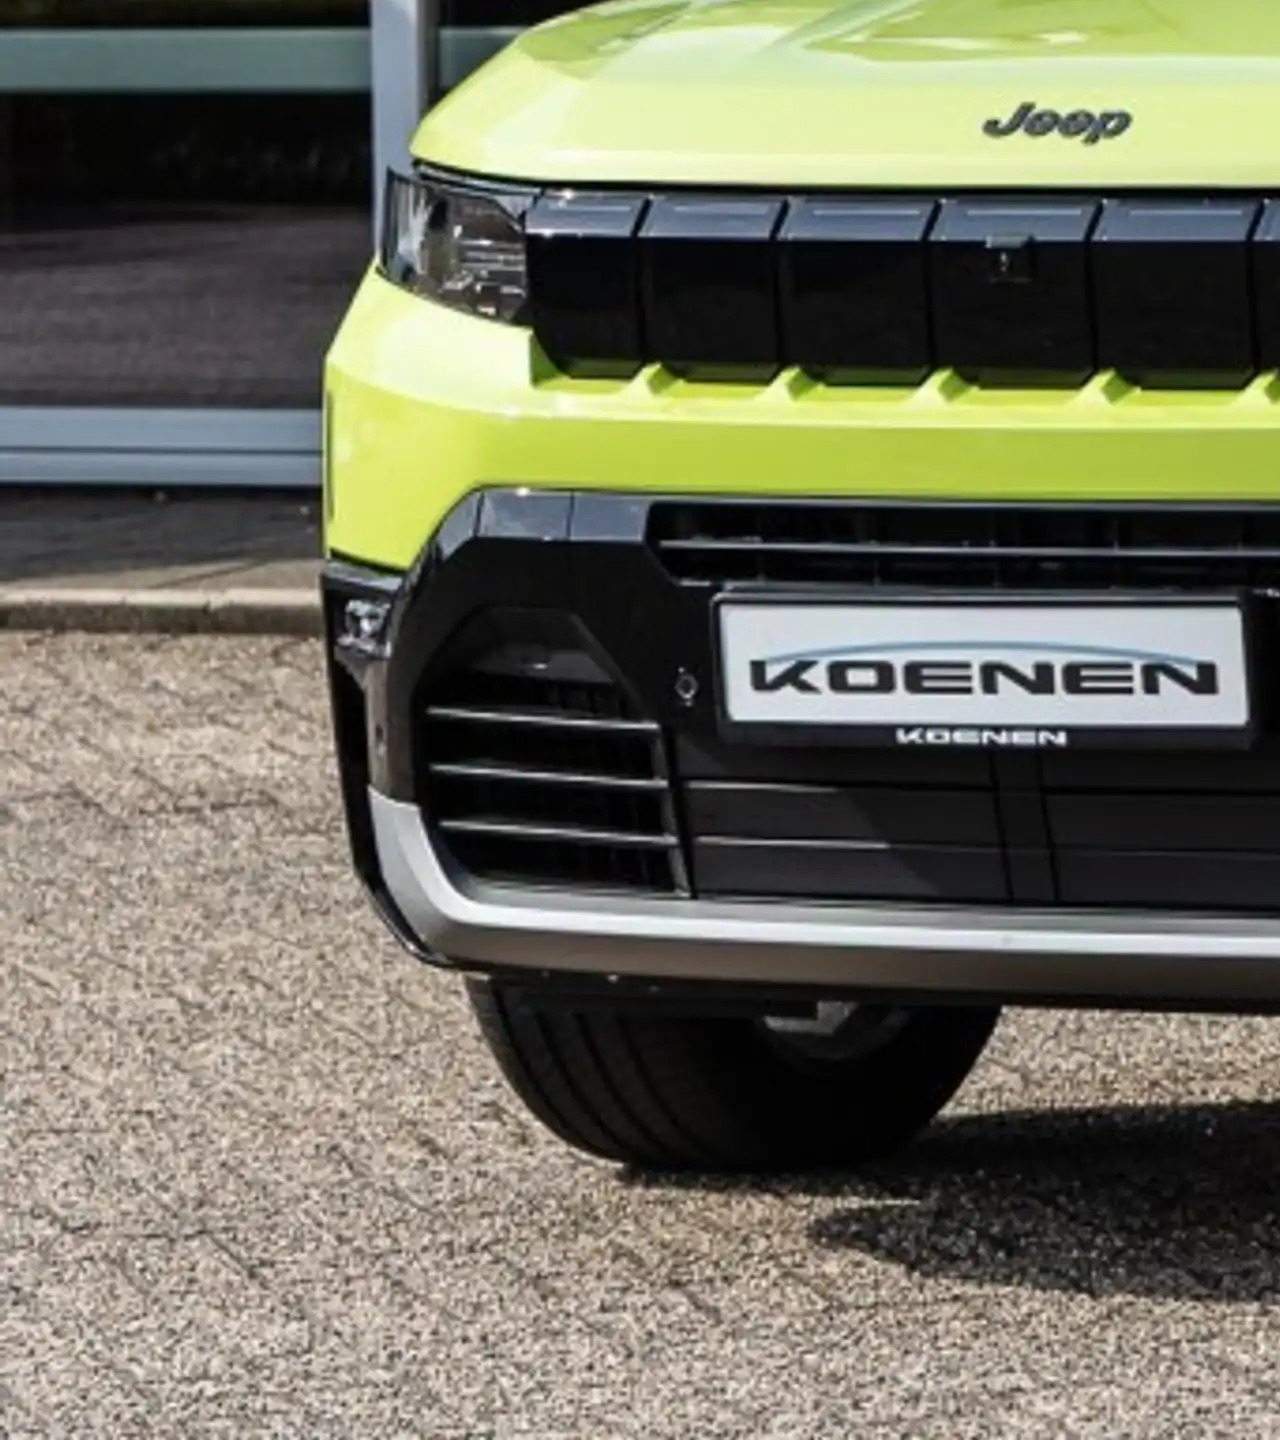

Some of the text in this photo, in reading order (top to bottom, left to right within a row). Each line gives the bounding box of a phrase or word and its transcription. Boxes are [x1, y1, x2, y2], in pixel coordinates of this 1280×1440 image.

[982, 101, 1133, 146] Jeep
[749, 659, 1219, 696] KOENEN
[896, 727, 1068, 748] KOENEN
